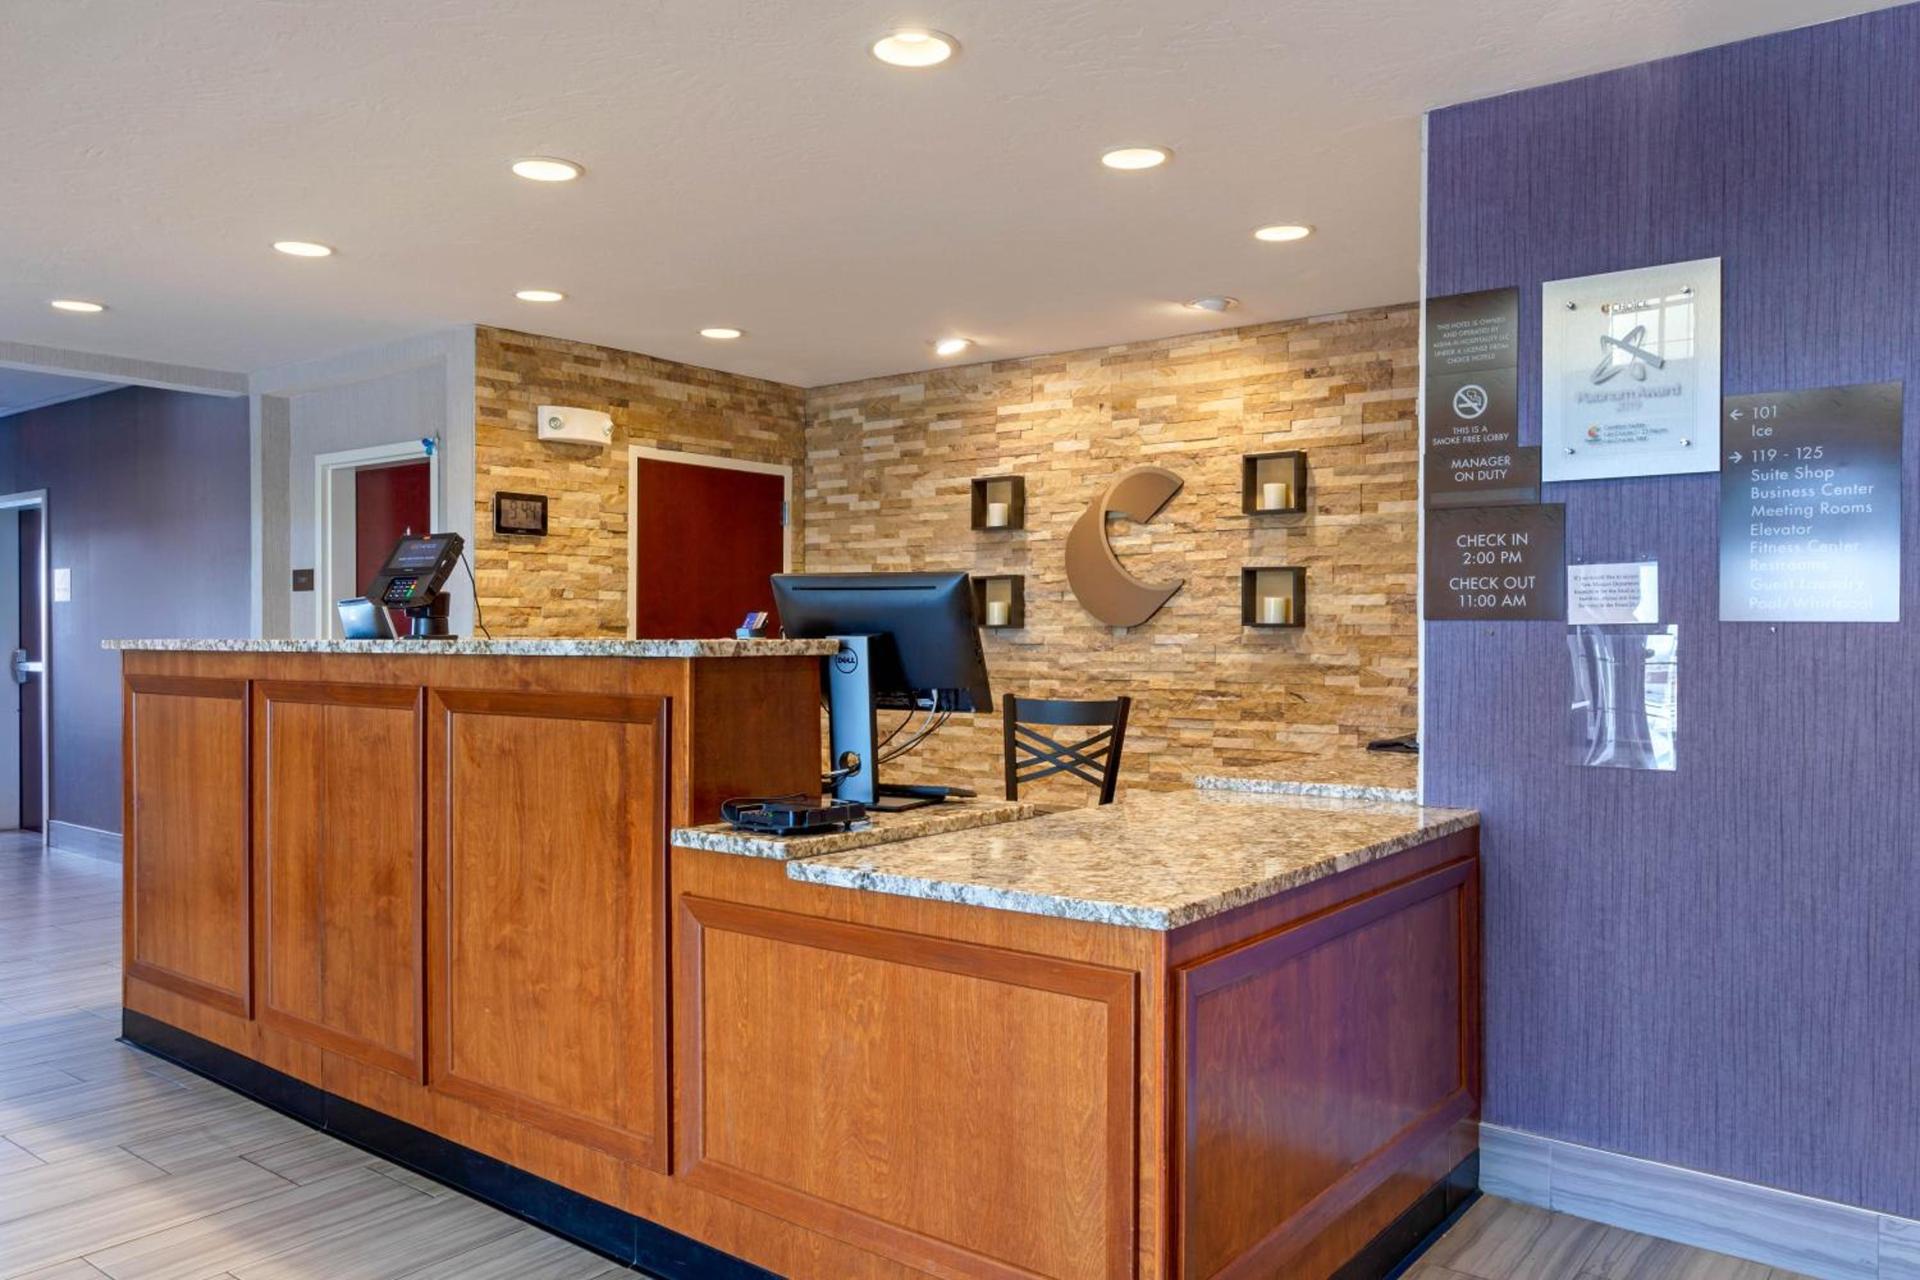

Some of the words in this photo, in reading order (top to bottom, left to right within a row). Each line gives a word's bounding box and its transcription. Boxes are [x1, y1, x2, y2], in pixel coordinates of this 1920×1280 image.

[1752, 405, 1778, 420] 101
[1453, 427, 1470, 435] THIS
[1471, 426, 1479, 434] IS
[1751, 424, 1774, 437] Ice
[1433, 436, 1461, 446] SMOKE
[1462, 434, 1481, 443] FREE
[1483, 432, 1510, 442] LOBBY
[1451, 454, 1511, 469] MANAGER
[1751, 448, 1777, 463] 119
[1795, 446, 1824, 460] 125
[1454, 471, 1474, 482] ON
[1477, 469, 1508, 480] DUTY
[1751, 467, 1789, 482] Suite
[1794, 464, 1835, 481] Shop
[1751, 485, 1816, 500] Business
[1821, 482, 1875, 497] Center
[1751, 503, 1814, 519] Meeting
[1820, 502, 1873, 515] Rooms
[1750, 522, 1813, 537] Elevator
[1456, 533, 1507, 548] CHECK
[1511, 532, 1529, 546] IN
[1750, 540, 1800, 554] Fitness
[1807, 538, 1862, 553] Center
[1463, 551, 1496, 565] 2:00
[1500, 551, 1523, 563] PM
[1449, 577, 1500, 590] CHECK
[1503, 575, 1537, 590] OUT
[1459, 594, 1497, 608] 11:00
[1501, 594, 1527, 607] AM
